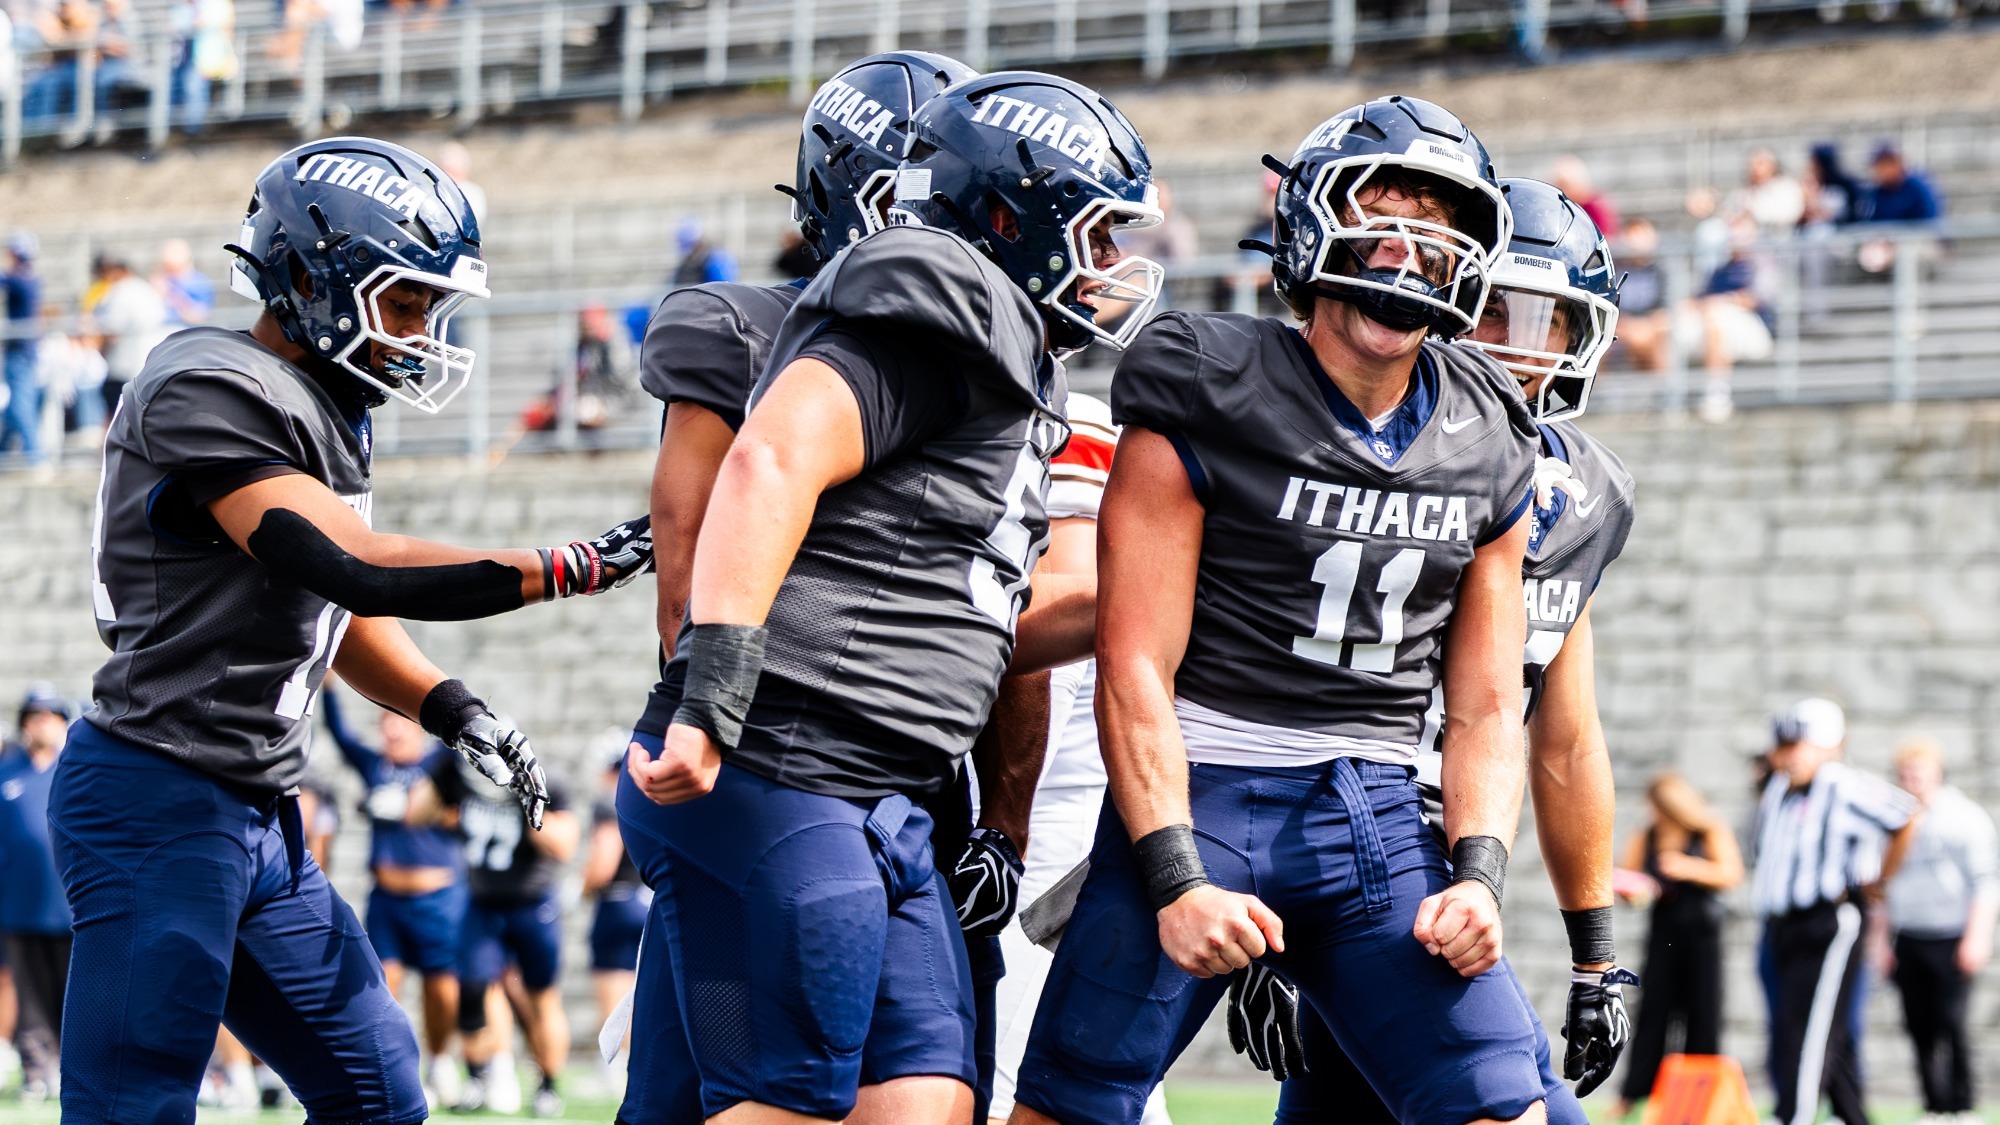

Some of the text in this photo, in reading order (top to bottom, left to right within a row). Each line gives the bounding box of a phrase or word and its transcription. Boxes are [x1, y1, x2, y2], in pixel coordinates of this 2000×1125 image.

[970, 93, 1111, 180] ITHACA
[293, 153, 427, 224] ITHACA
[1514, 255, 1553, 270] BOMBERS
[1277, 476, 1469, 542] ITHACA
[1292, 540, 1426, 674] 11
